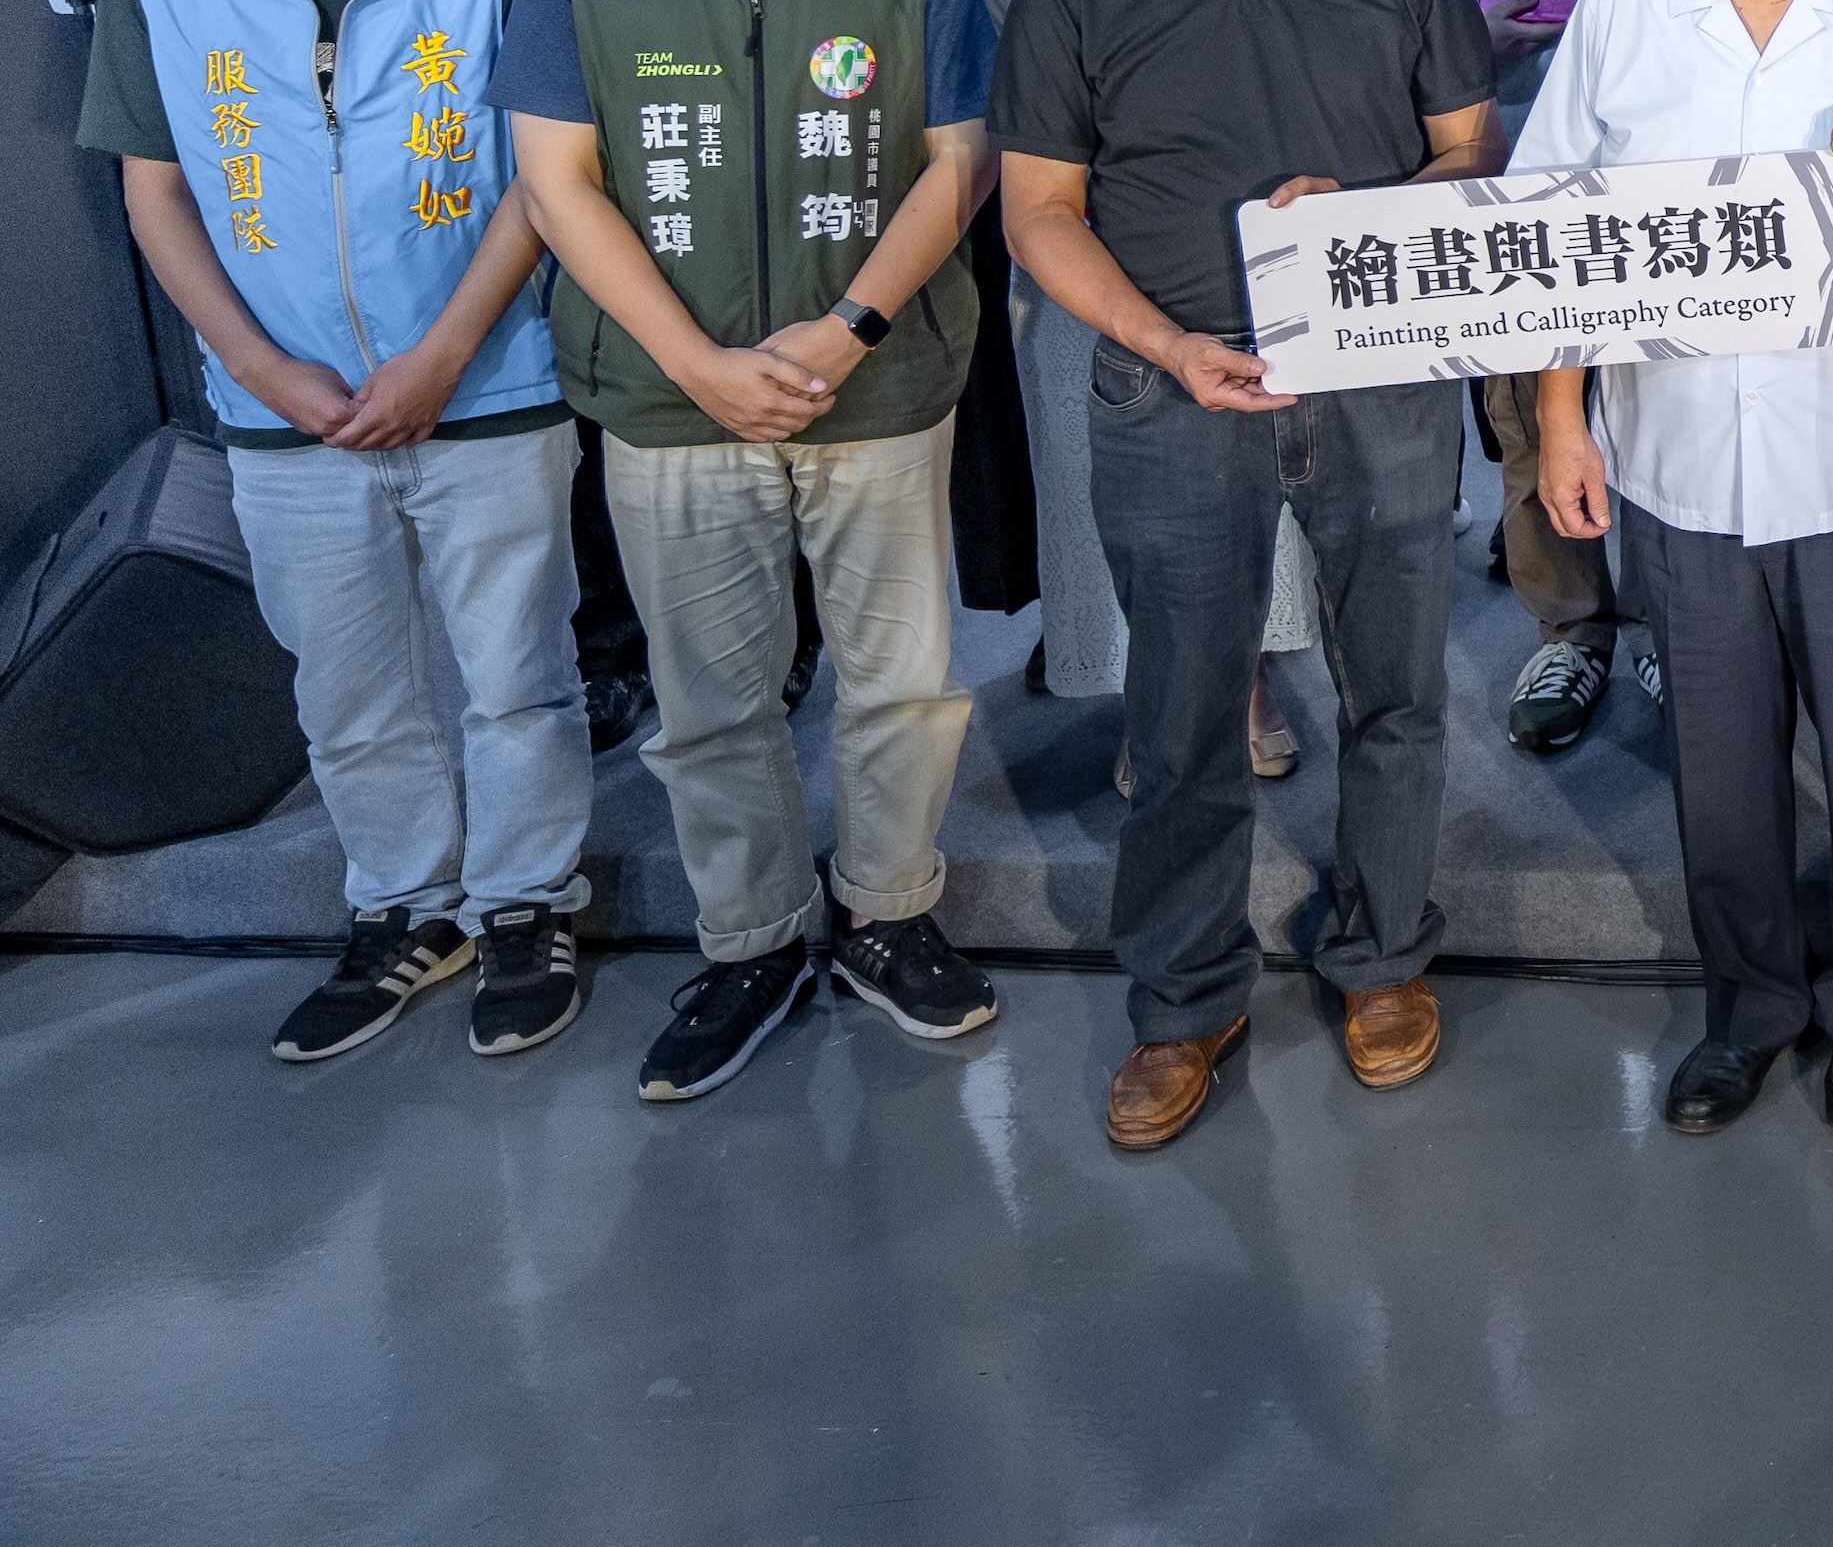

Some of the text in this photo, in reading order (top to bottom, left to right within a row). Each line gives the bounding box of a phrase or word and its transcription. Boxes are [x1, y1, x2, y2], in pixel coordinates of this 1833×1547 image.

[635, 52, 673, 64] TEAM
[637, 65, 710, 77] ZHONGLI
[205, 49, 279, 255] 服務團隊
[401, 31, 477, 232] 黃婉如
[698, 104, 722, 167] 副主任
[867, 109, 881, 188] 桃園市議員
[641, 103, 693, 257] 莊秉璋
[1325, 198, 1793, 309] 繪畫與書寫類
[1335, 292, 1796, 350] Painting and Calligraphy Category
